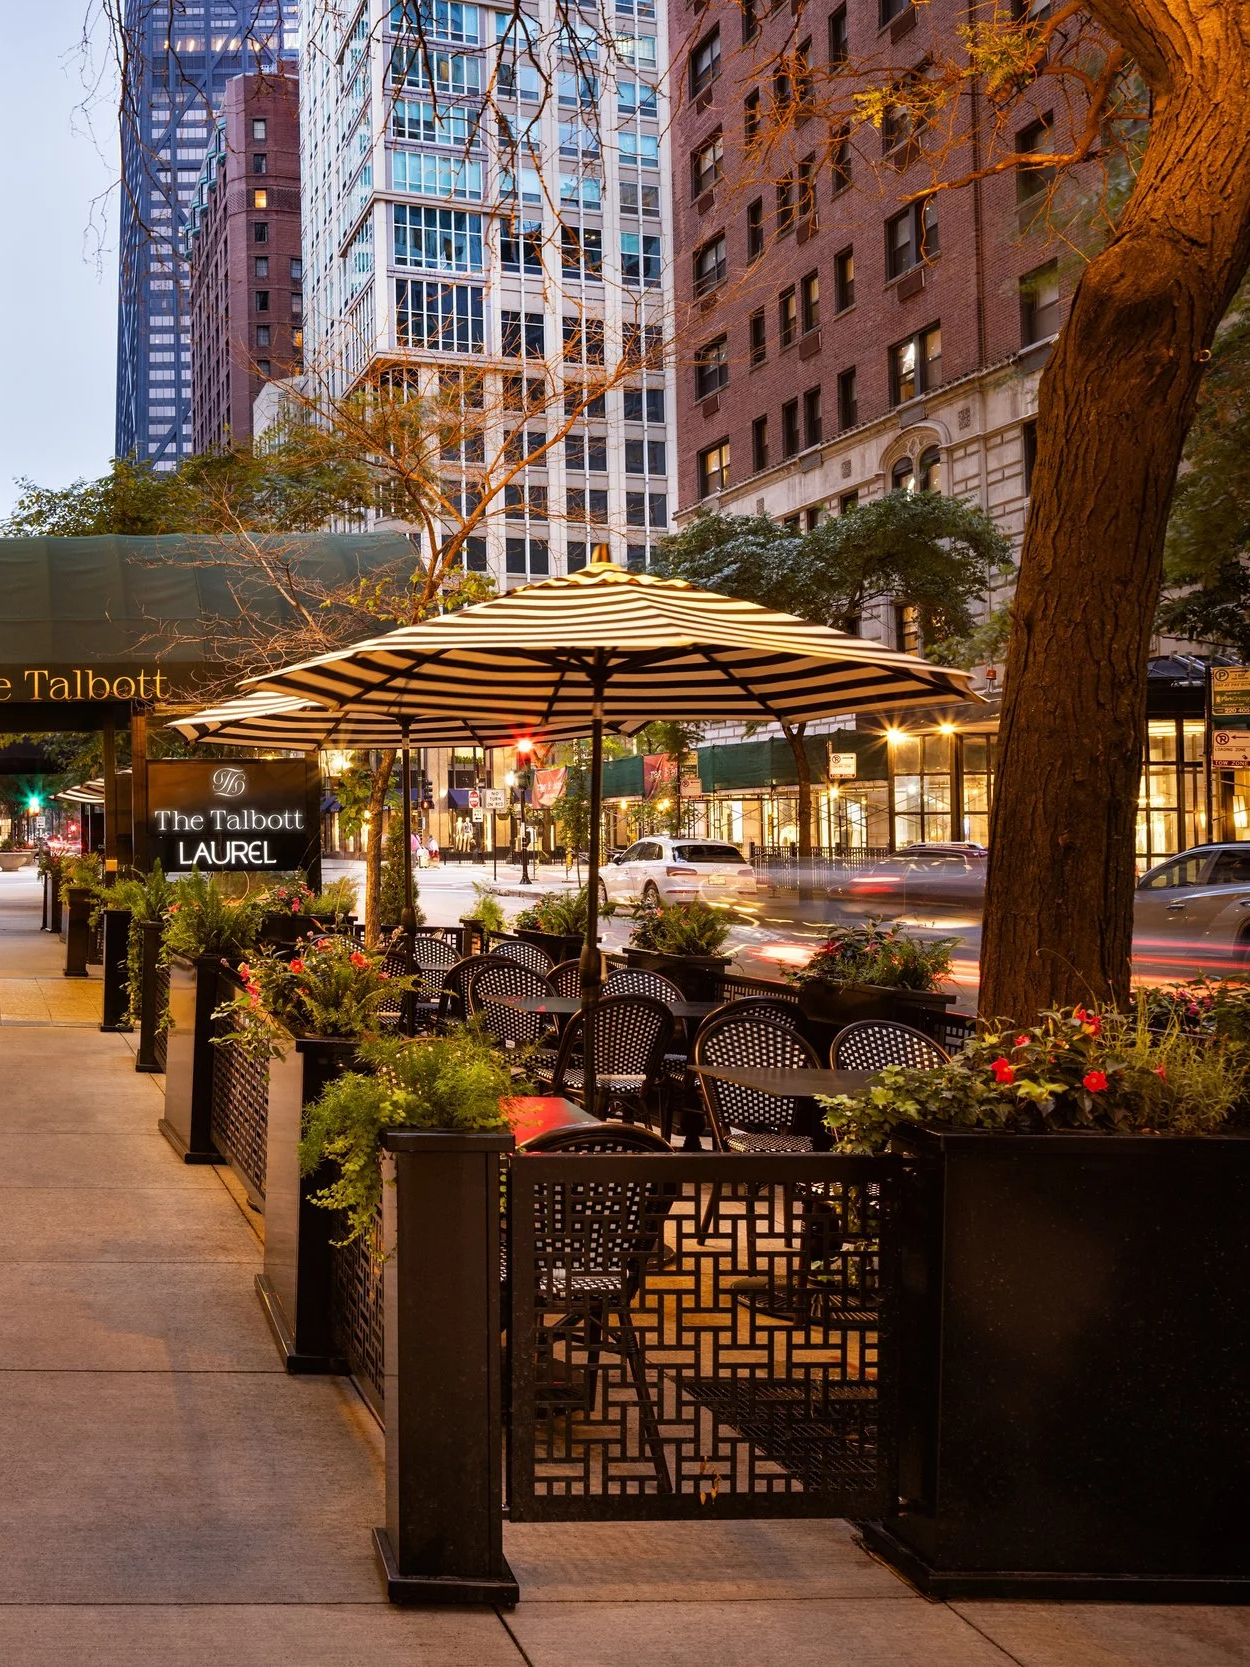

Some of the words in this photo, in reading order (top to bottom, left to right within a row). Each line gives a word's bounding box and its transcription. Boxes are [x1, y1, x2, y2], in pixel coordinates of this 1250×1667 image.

[24, 669, 169, 700] Talbott
[155, 810, 204, 831] The
[210, 809, 305, 831] Talbott
[179, 840, 277, 865] LAUREL
